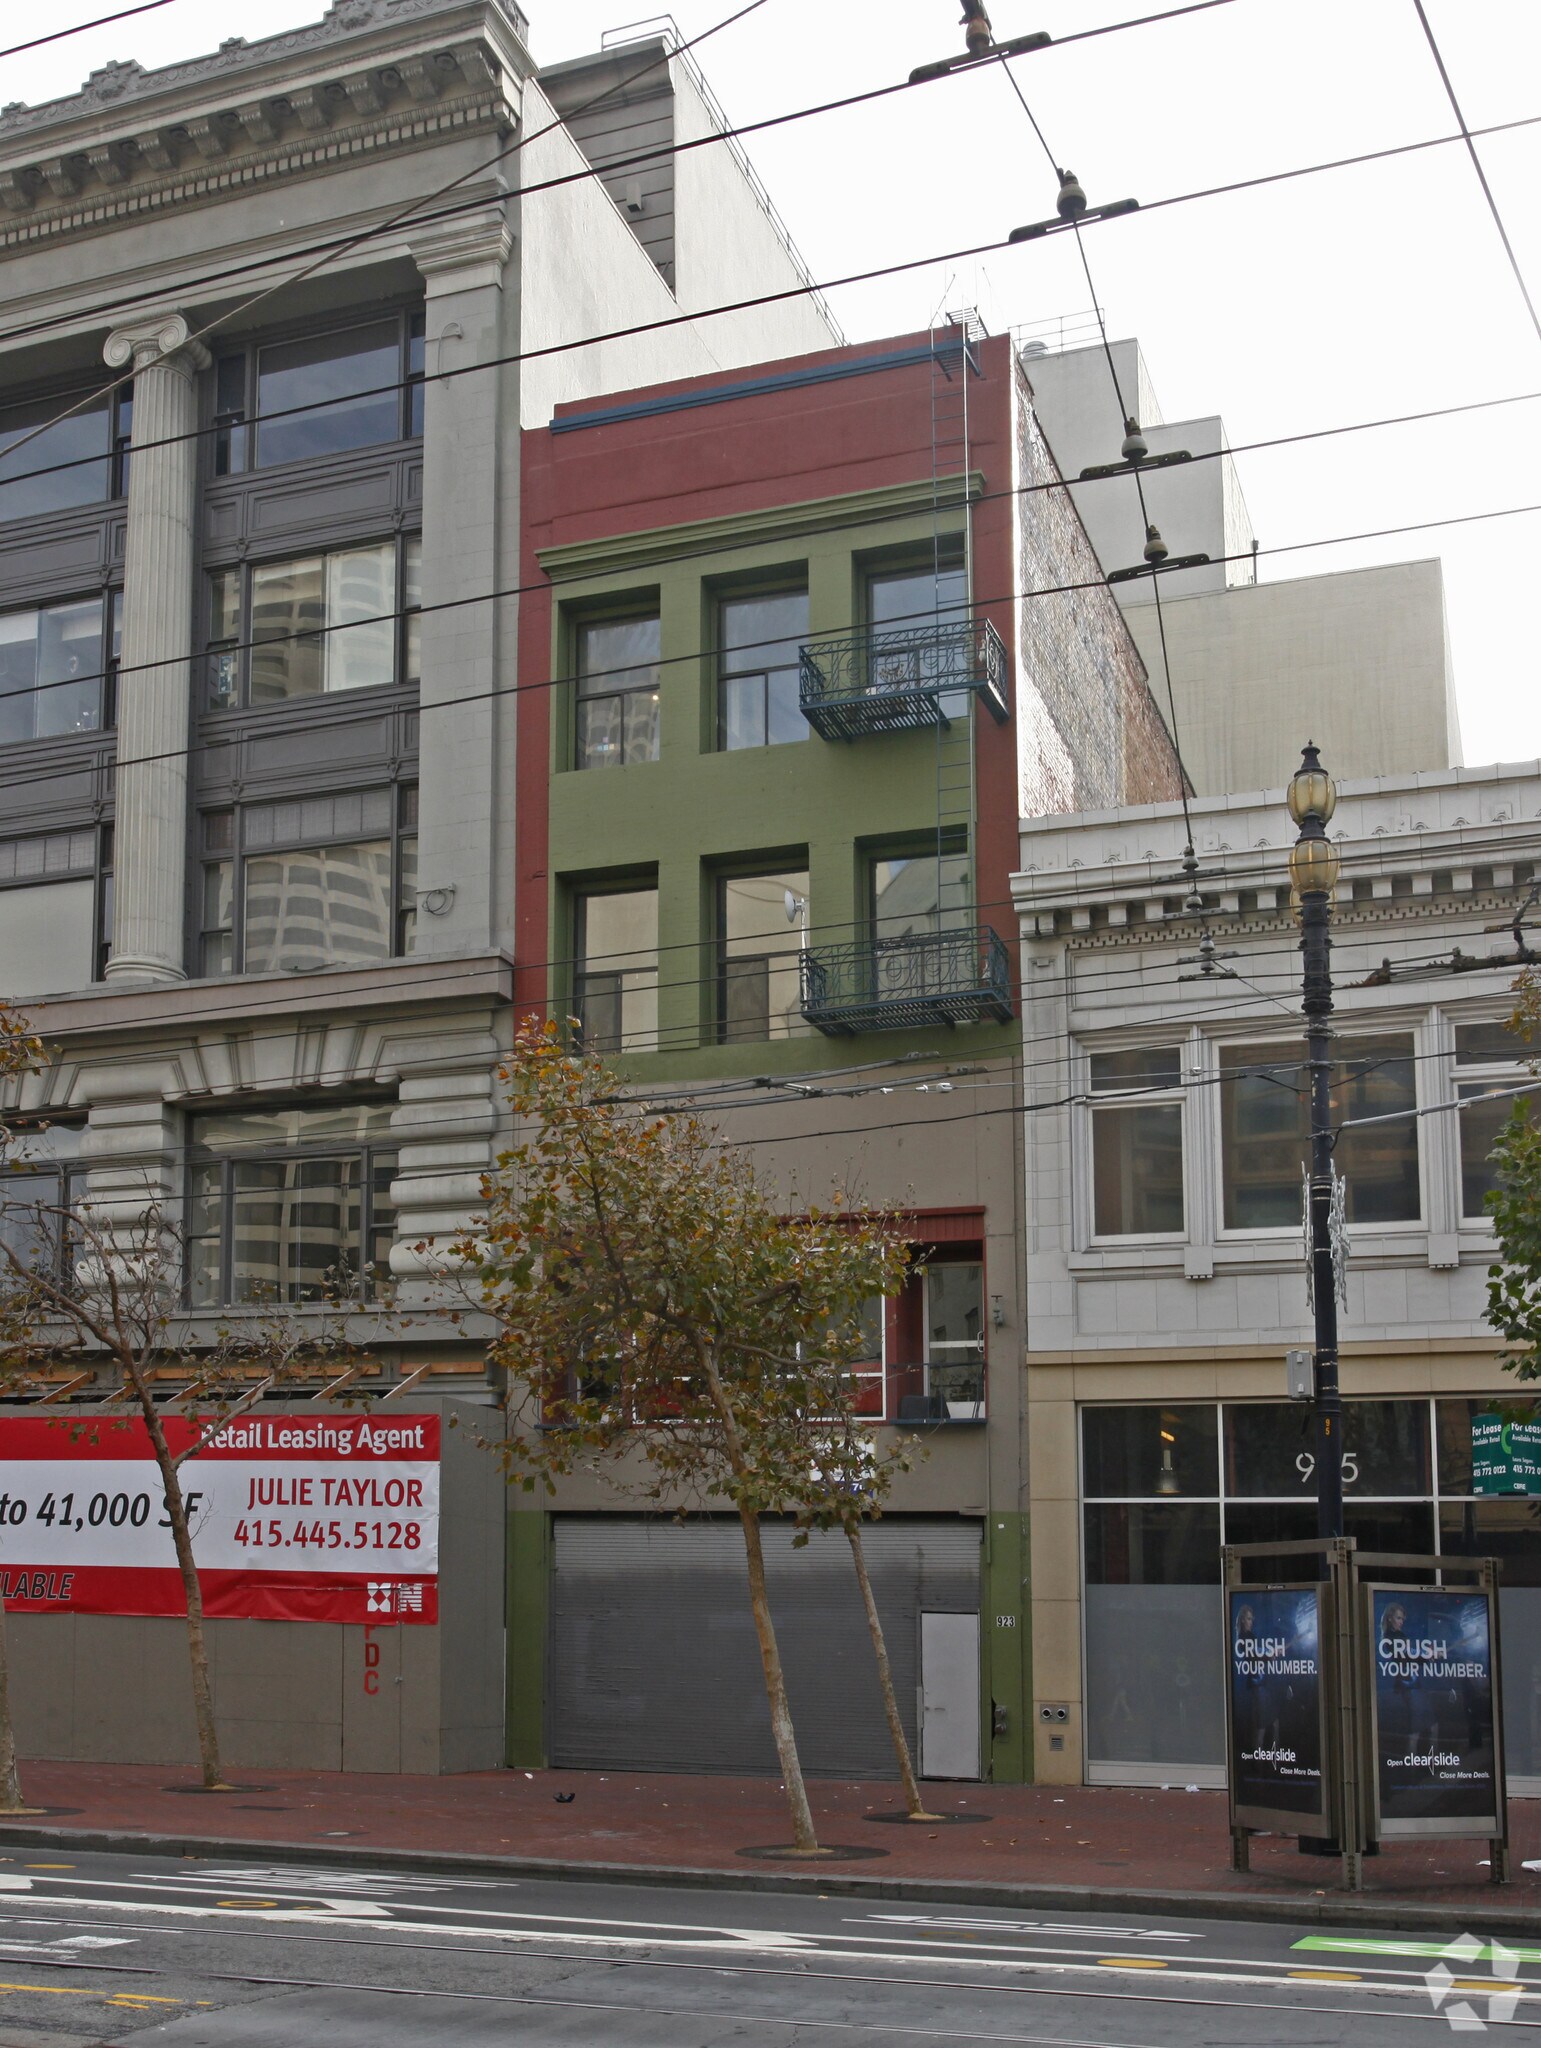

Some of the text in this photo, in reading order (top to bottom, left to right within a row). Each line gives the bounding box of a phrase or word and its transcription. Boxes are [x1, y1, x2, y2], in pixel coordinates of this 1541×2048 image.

[1472, 1424, 1502, 1436] For Lease
[267, 1423, 353, 1454] Leasing
[356, 1423, 424, 1455] Agent
[1295, 1452, 1359, 1483] 95
[1482, 1467, 1492, 1475] 772
[1513, 1464, 1523, 1473] 415
[1524, 1465, 1535, 1474] 772
[247, 1478, 423, 1510] JULIE TAYLOR
[36, 1492, 150, 1532] 41,000
[234, 1520, 421, 1550] 415.445.5128
[0, 1572, 75, 1600] LABLE
[997, 1616, 1014, 1626] 923
[1235, 1638, 1285, 1658] CRUSH
[1378, 1638, 1447, 1659] CRUSH
[1235, 1660, 1317, 1675] YOUR NUMBER.
[1379, 1662, 1487, 1678] YOUR NUMBER.
[1241, 1752, 1253, 1760] Open
[1387, 1759, 1403, 1767] Open
[1280, 1767, 1293, 1775] Close
